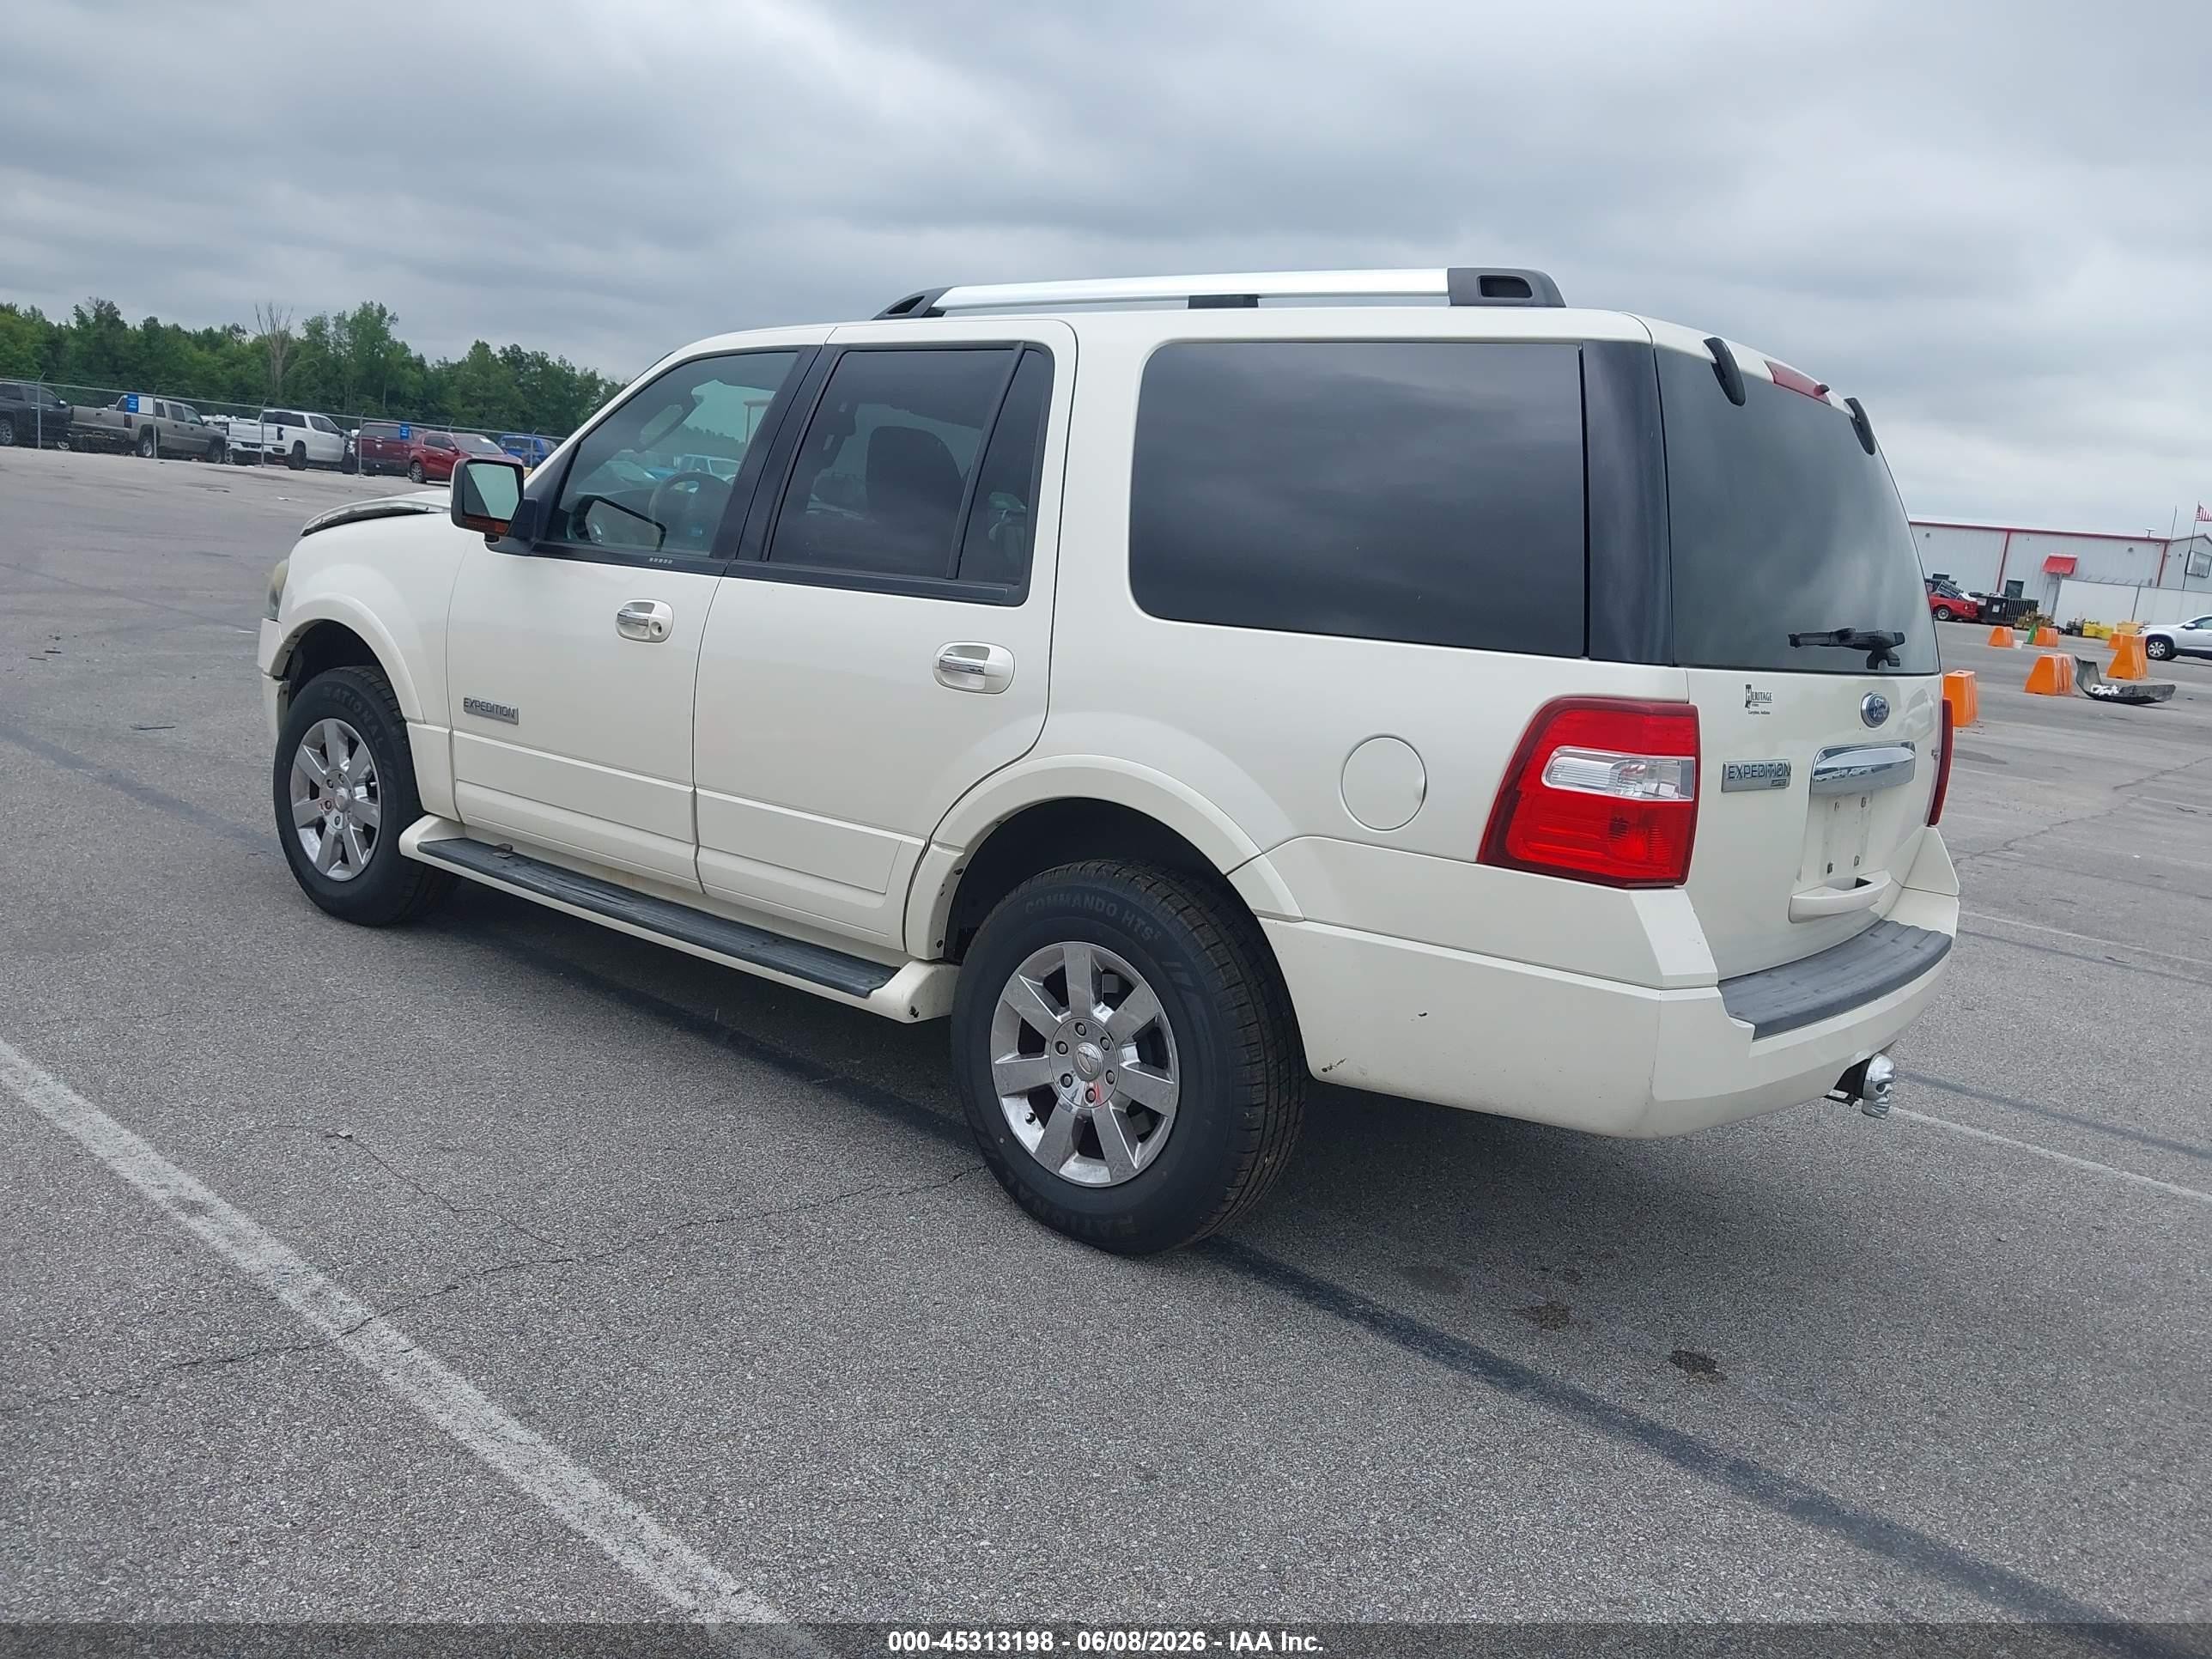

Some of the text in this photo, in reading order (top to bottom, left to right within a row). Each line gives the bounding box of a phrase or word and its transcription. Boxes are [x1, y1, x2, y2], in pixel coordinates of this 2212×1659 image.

[1745, 688, 1773, 701] HERITAGE
[464, 697, 515, 719] EXPEDITION
[1729, 763, 1792, 779] EXPEDITION
[1025, 894, 1117, 917] COMMANDO
